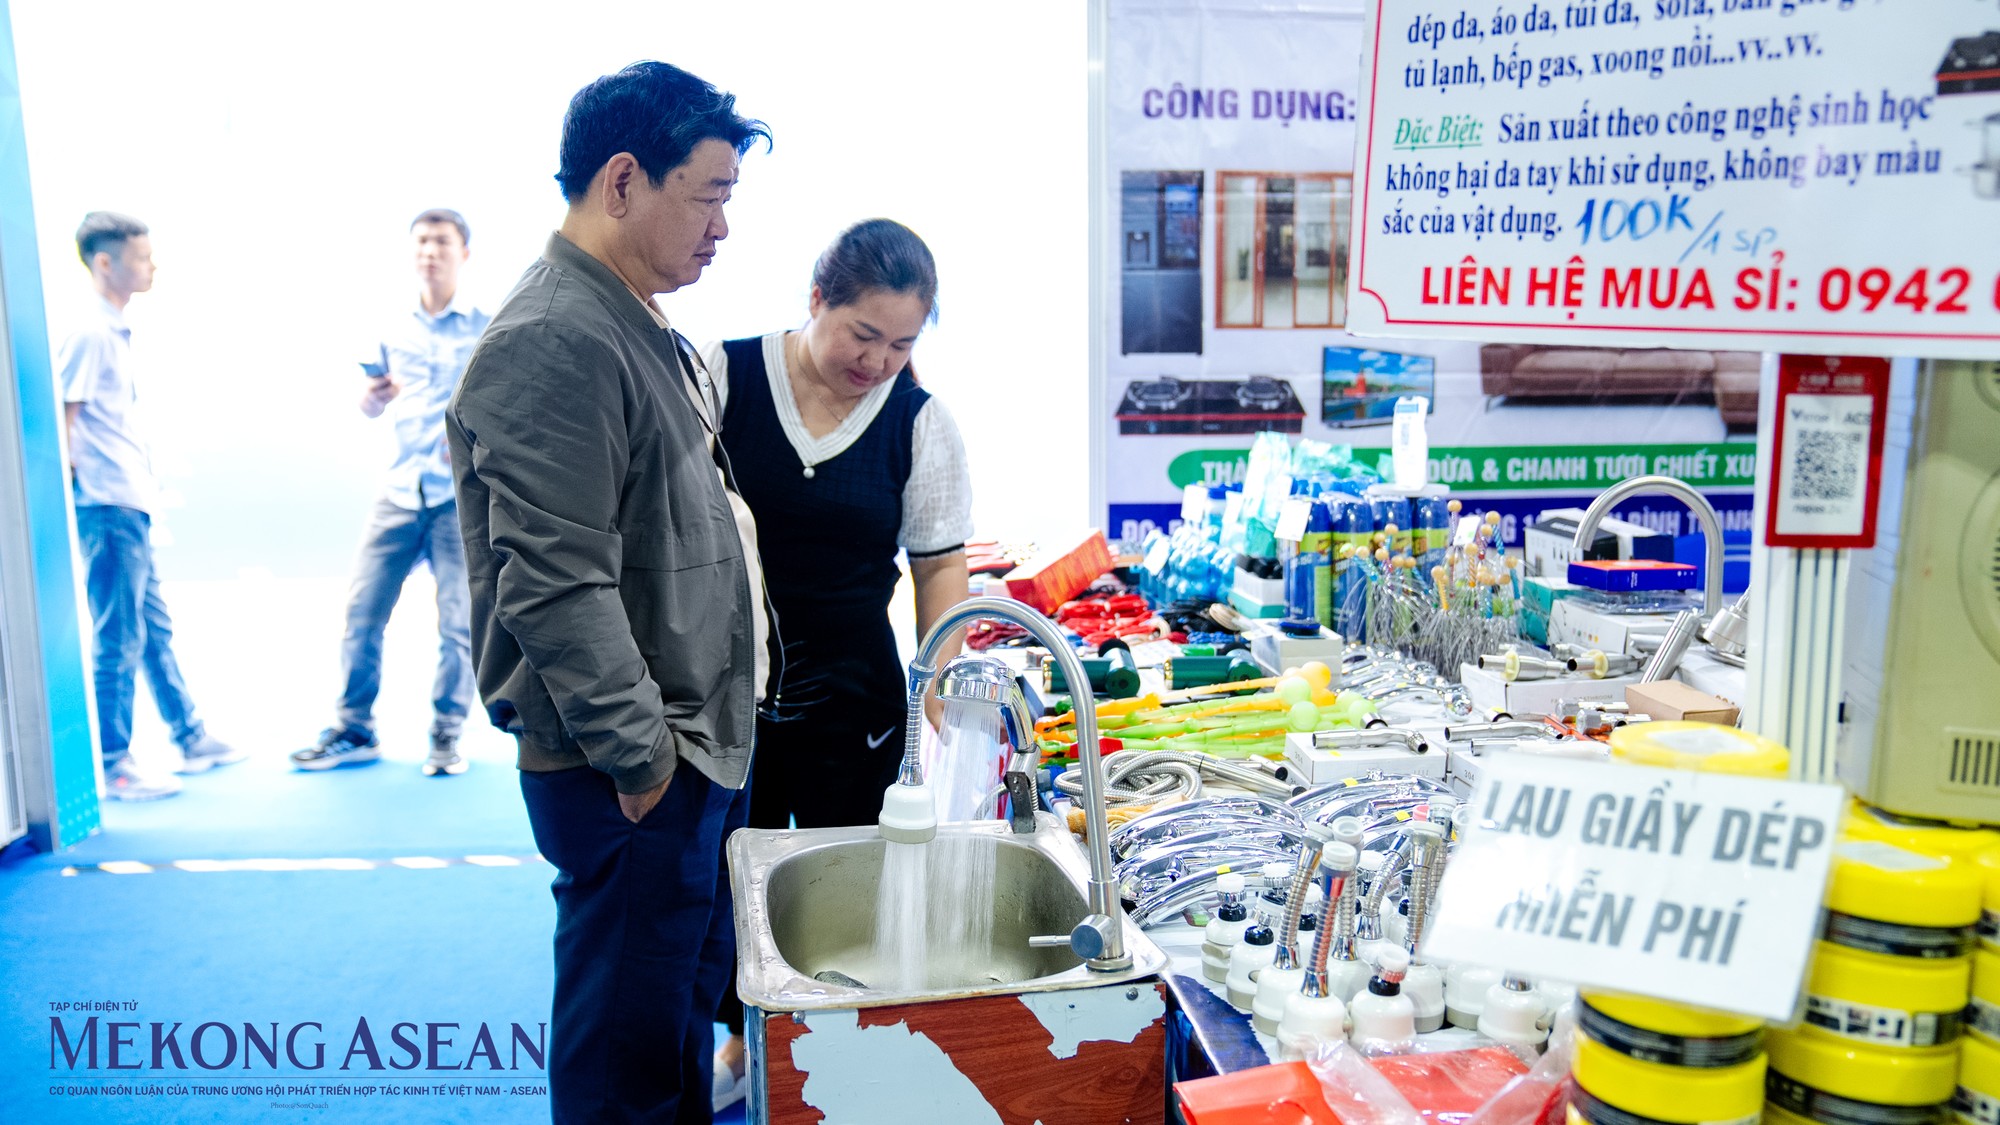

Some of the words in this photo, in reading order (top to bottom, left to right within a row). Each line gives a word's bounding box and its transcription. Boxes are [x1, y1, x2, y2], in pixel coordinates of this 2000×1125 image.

[1408, 13, 1446, 50] dép
[1452, 11, 1484, 43] da,
[1491, 5, 1517, 36] áo
[1523, 3, 1558, 38] da,
[1566, 0, 1596, 29] túi
[1604, 0, 1640, 30] da,
[1405, 59, 1426, 88] tủ
[1431, 55, 1485, 94] lạnh,
[1492, 41, 1533, 90] bếp
[1538, 54, 1583, 88] gas,
[1590, 48, 1664, 80] xoong
[1142, 82, 1239, 120] CÔNG
[1252, 87, 1355, 128] DỤNG:
[1394, 117, 1432, 151] Đặc
[1437, 113, 1483, 149] Biệt:
[1497, 112, 1540, 143] Sản
[1548, 98, 1600, 140] xuất
[1607, 106, 1659, 138] theo
[1667, 101, 1727, 143] công
[1734, 96, 1800, 139] nghệ
[1808, 91, 1868, 127] sinh
[1878, 88, 1934, 131] học
[1386, 161, 1450, 199] không
[1456, 160, 1491, 197] hại
[1495, 160, 1520, 189] da
[1526, 160, 1562, 196] tay
[1567, 155, 1606, 187] khi
[1610, 153, 1640, 186] sử
[1646, 152, 1716, 193] dụng,
[1724, 146, 1807, 190] không
[1815, 143, 1868, 187] bay
[1875, 138, 1942, 177] màu
[1382, 197, 1414, 235] sắc
[1419, 205, 1456, 235] của
[1462, 203, 1496, 242] vật
[1500, 204, 1562, 242] dụng.
[1421, 254, 1511, 306] LIÊN
[1526, 254, 1586, 322] HỆ
[1600, 266, 1716, 311] MUA
[1733, 248, 1799, 312] SỈ:
[1819, 266, 1972, 315] 0942
[1482, 457, 1500, 482] &
[1507, 456, 1587, 482] CHANH
[1653, 447, 1719, 480] CHIẾT
[1725, 454, 1757, 478] XU
[1480, 780, 1572, 839] LAU
[1712, 801, 1827, 872] DÉP
[1642, 898, 1747, 966] PHÍ
